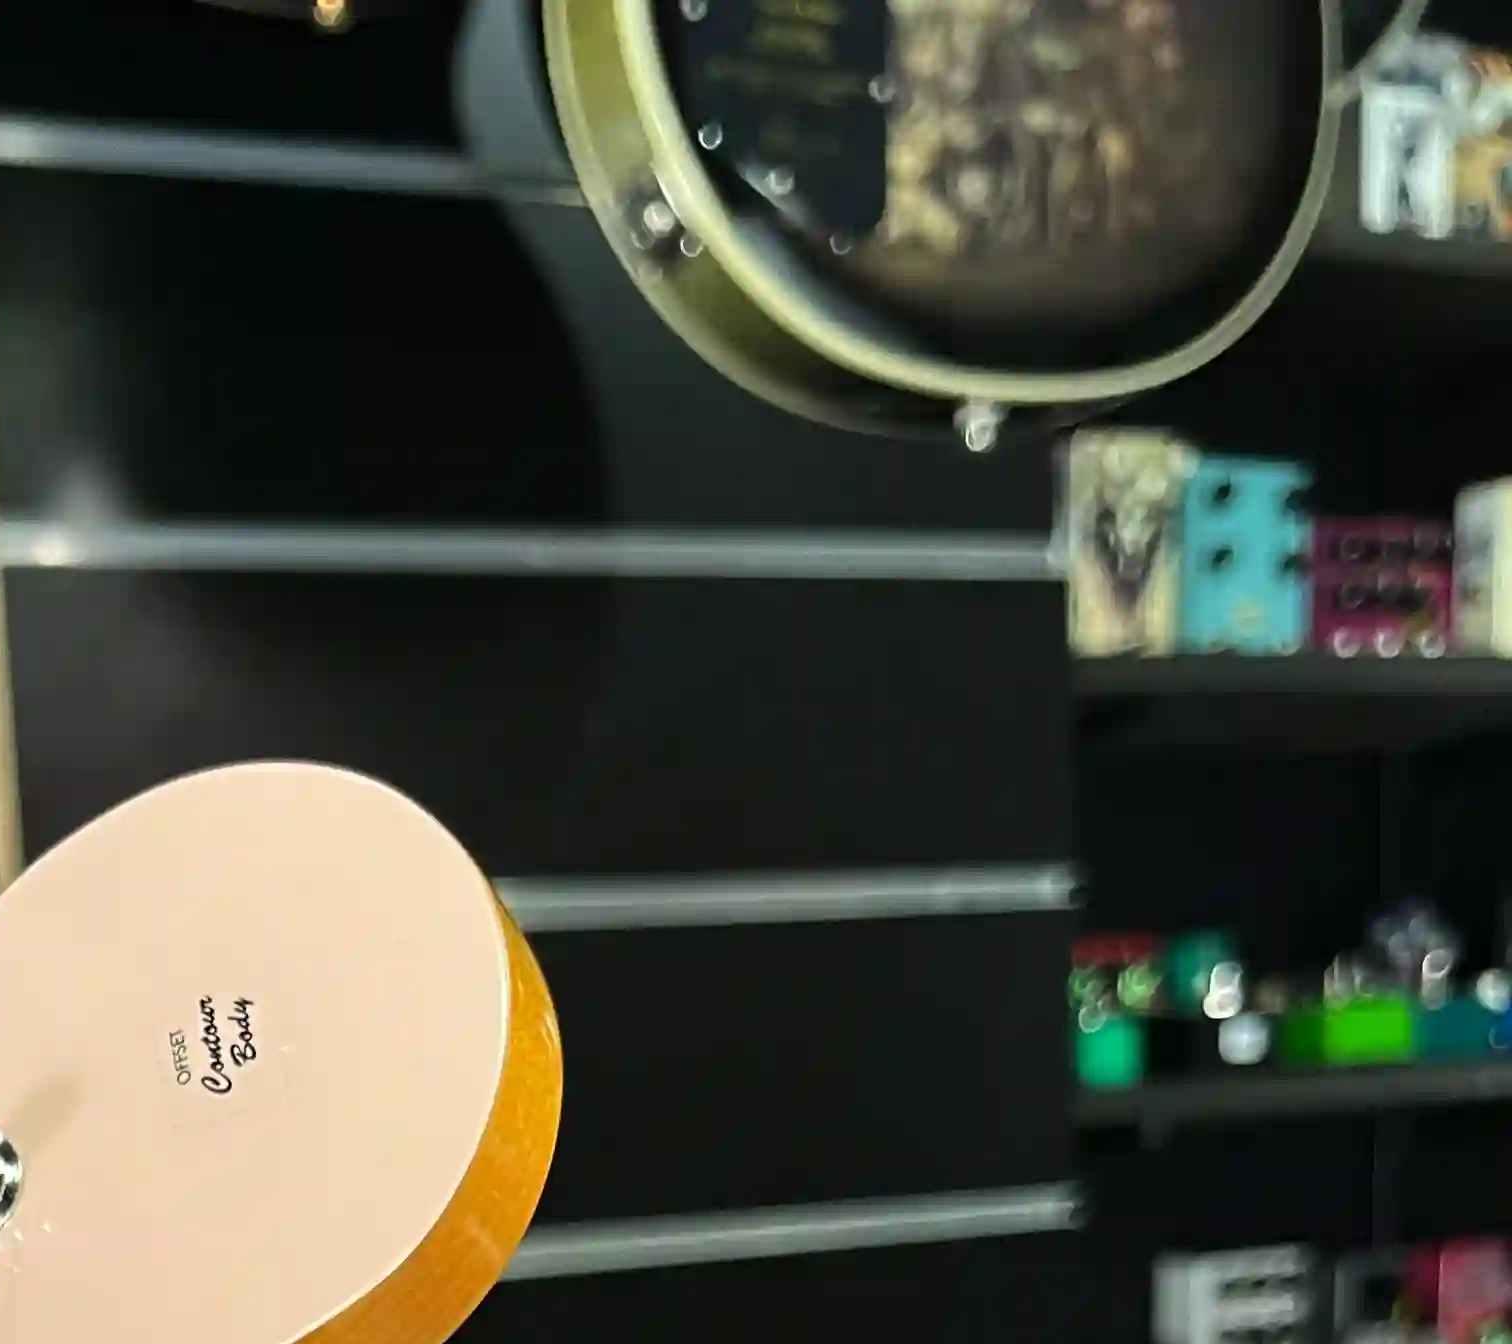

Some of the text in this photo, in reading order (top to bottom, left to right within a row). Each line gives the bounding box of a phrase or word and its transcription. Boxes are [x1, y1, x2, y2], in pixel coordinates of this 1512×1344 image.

[169, 1029, 192, 1086] OFFSET
[199, 995, 233, 1095] Contour
[227, 997, 257, 1068] Body
